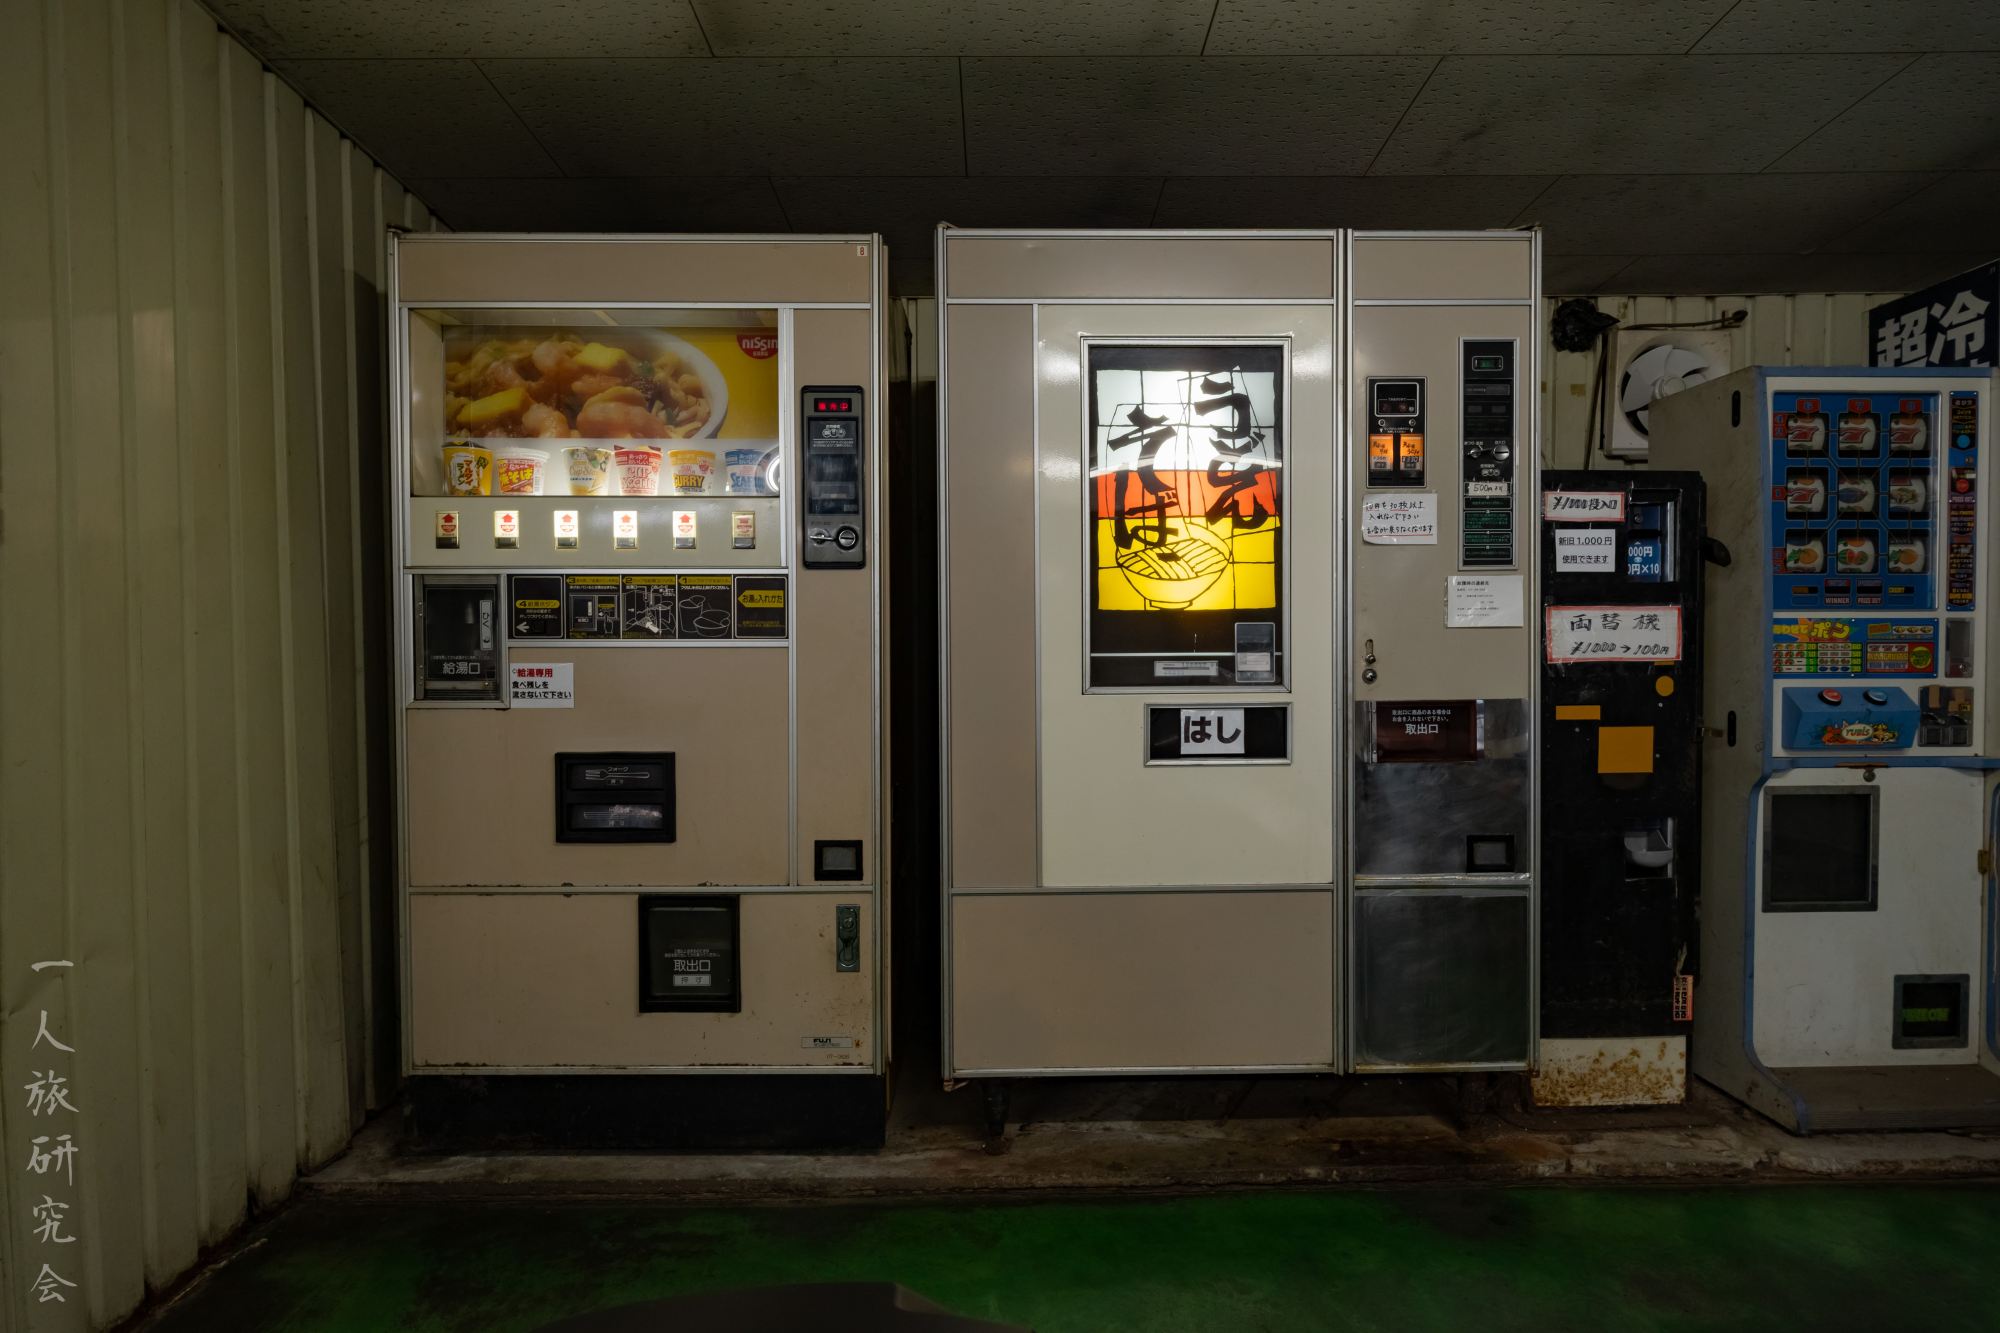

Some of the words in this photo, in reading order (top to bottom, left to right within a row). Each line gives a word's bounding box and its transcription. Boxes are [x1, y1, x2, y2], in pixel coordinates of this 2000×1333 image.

[859, 246, 865, 256] 8
[1194, 376, 1268, 530] うどん
[673, 475, 705, 488] CURRY
[1108, 404, 1180, 550] そば
[1562, 555, 1609, 564] 使用できます
[1810, 621, 1850, 639] ポン
[442, 662, 481, 675] 給湯口
[517, 668, 553, 678] 給湯専用
[512, 681, 549, 689] 食べ残しを
[512, 691, 572, 699] 流さないで下さい
[1183, 716, 1242, 744] はし
[1404, 723, 1440, 736] 取出口
[673, 959, 711, 972] 取出口
